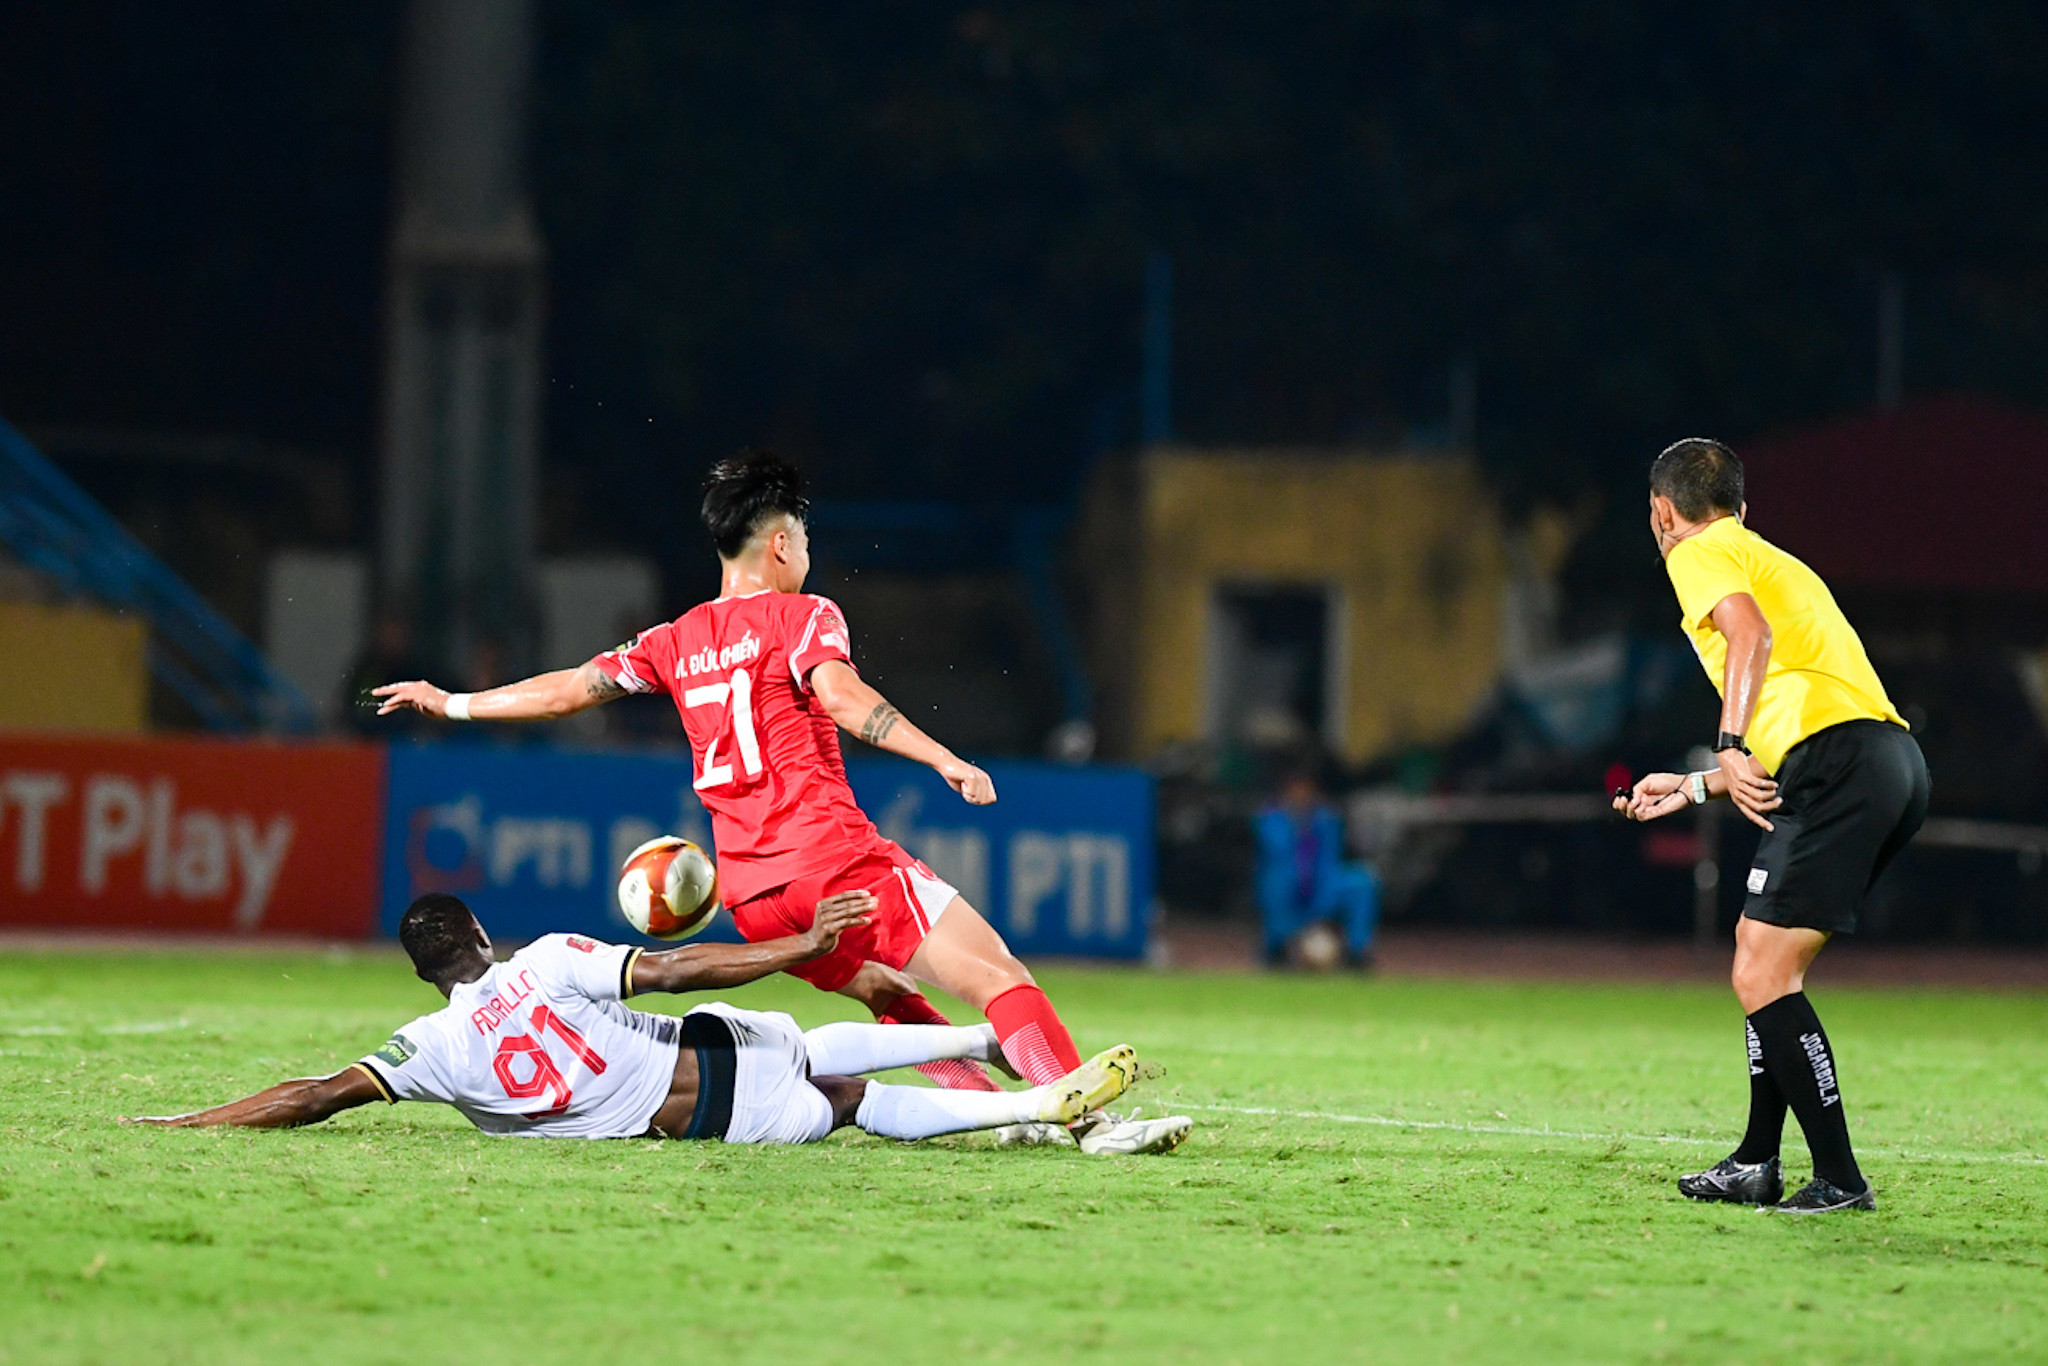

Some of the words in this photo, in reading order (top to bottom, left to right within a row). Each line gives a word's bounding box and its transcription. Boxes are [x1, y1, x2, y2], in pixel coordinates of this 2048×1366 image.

[684, 668, 763, 790] 21
[0, 774, 66, 894] T
[82, 774, 293, 930] Play
[1007, 828, 1133, 940] PTI
[493, 1004, 607, 1120] 91
[1800, 1032, 1840, 1107] JOGARBOLA
